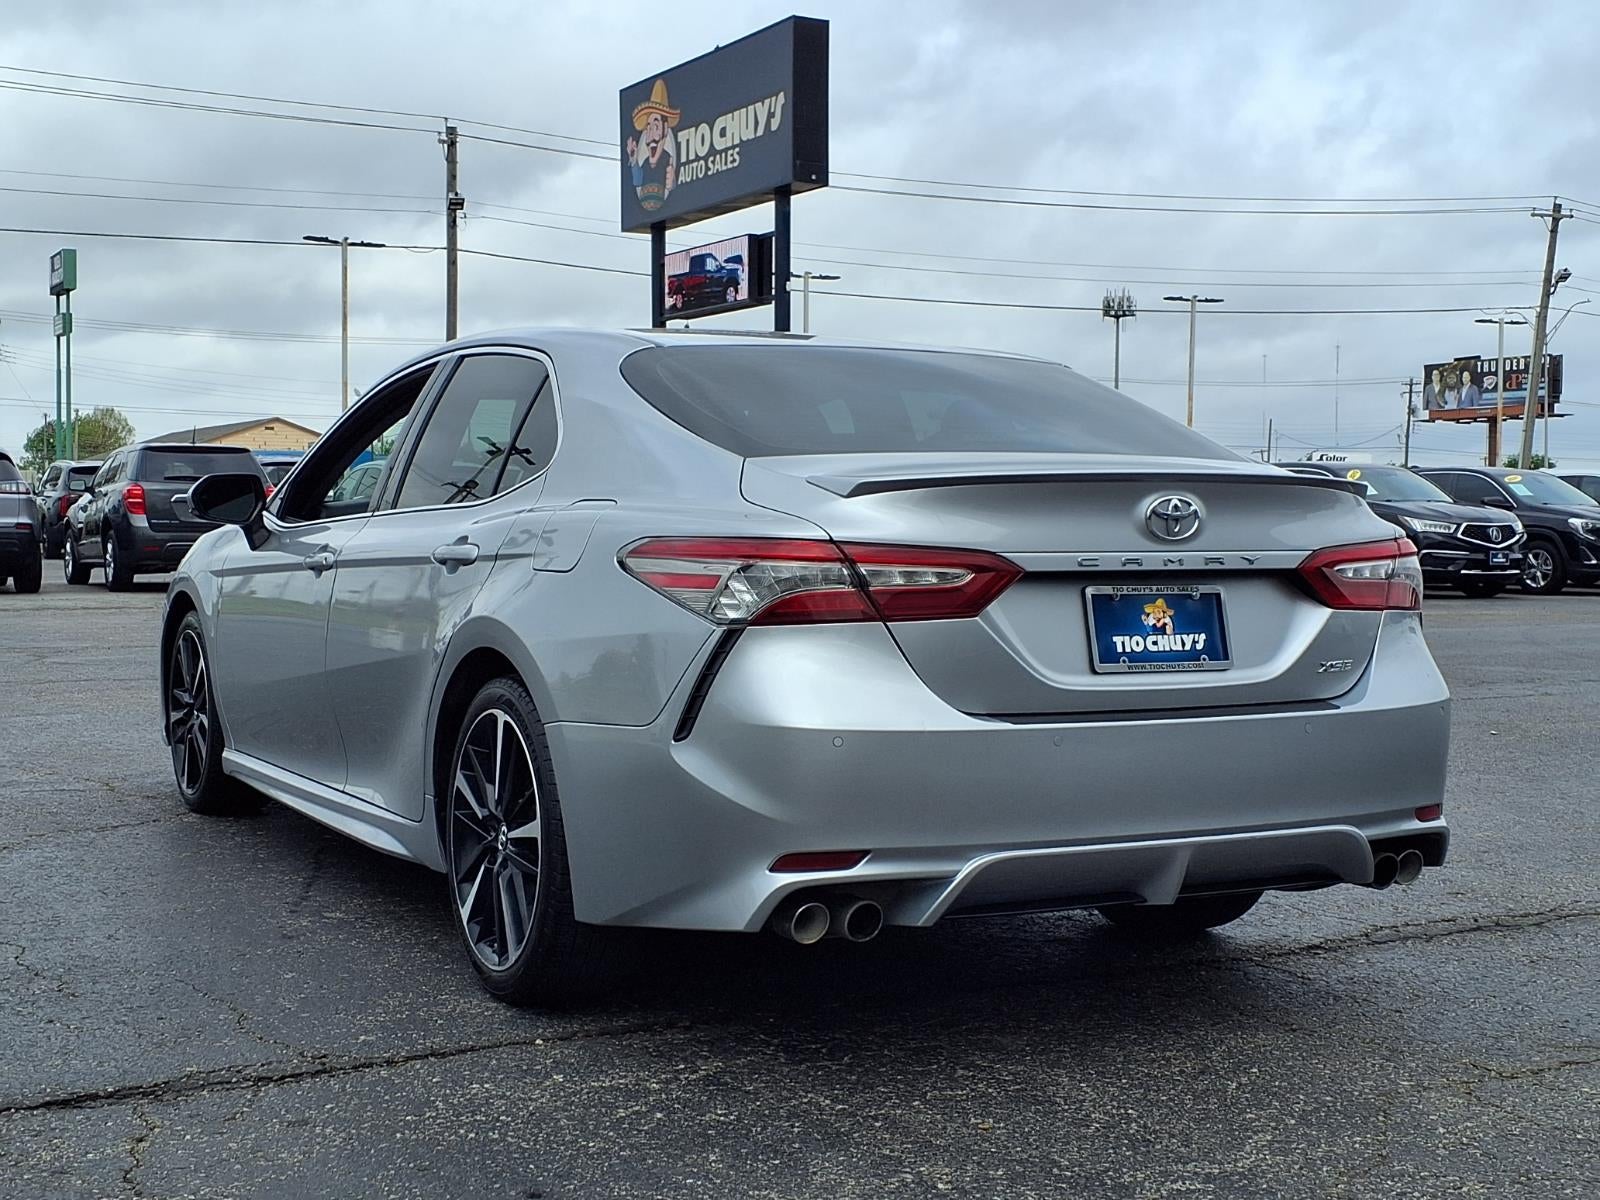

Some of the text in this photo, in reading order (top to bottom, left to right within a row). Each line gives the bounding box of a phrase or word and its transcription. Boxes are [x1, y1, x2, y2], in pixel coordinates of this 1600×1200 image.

[677, 91, 785, 163] TIO CHUY'S
[678, 147, 740, 185] AUTO SALES
[1477, 358, 1525, 373] THUDER
[1077, 555, 1261, 567] CAMRY
[1112, 633, 1207, 653] TIO CHUY'S
